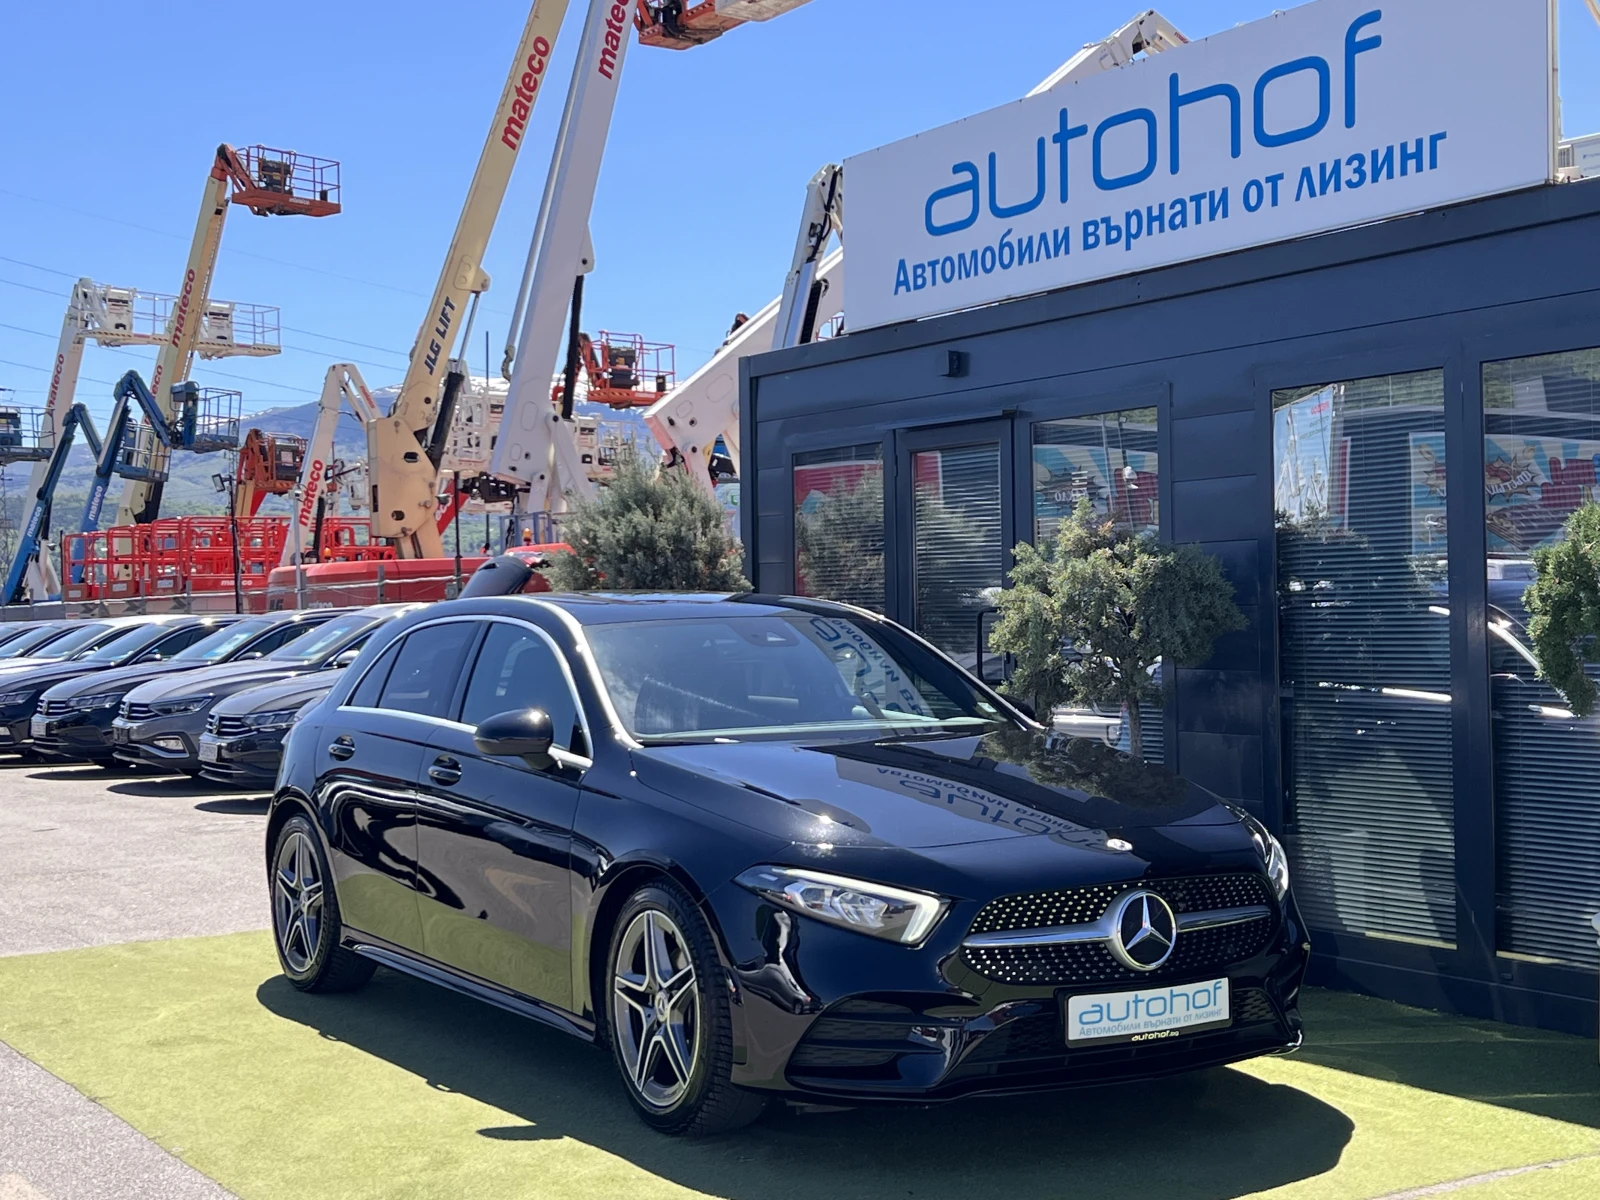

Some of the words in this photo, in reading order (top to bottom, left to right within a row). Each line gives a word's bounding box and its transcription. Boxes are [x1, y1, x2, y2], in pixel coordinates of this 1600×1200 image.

[501, 36, 550, 151] mateco
[925, 9, 1382, 236] autohof
[894, 228, 1070, 295] Автомобили
[1082, 187, 1229, 251] върнати
[1242, 172, 1284, 212] от
[1295, 131, 1447, 202] лизинг
[172, 268, 195, 349] mateco
[424, 339, 442, 376] JLG
[435, 296, 456, 339] LIFT
[26, 506, 43, 538] mateco
[88, 485, 103, 521] mateco
[298, 459, 323, 527] mateco
[1079, 981, 1222, 1025] autohof
[1079, 1021, 1140, 1037] Автомобили
[1144, 1016, 1181, 1029] върнати
[1183, 1013, 1193, 1022] от
[1194, 1008, 1222, 1020] лизинг
[1131, 1029, 1180, 1042] autohof.bg
